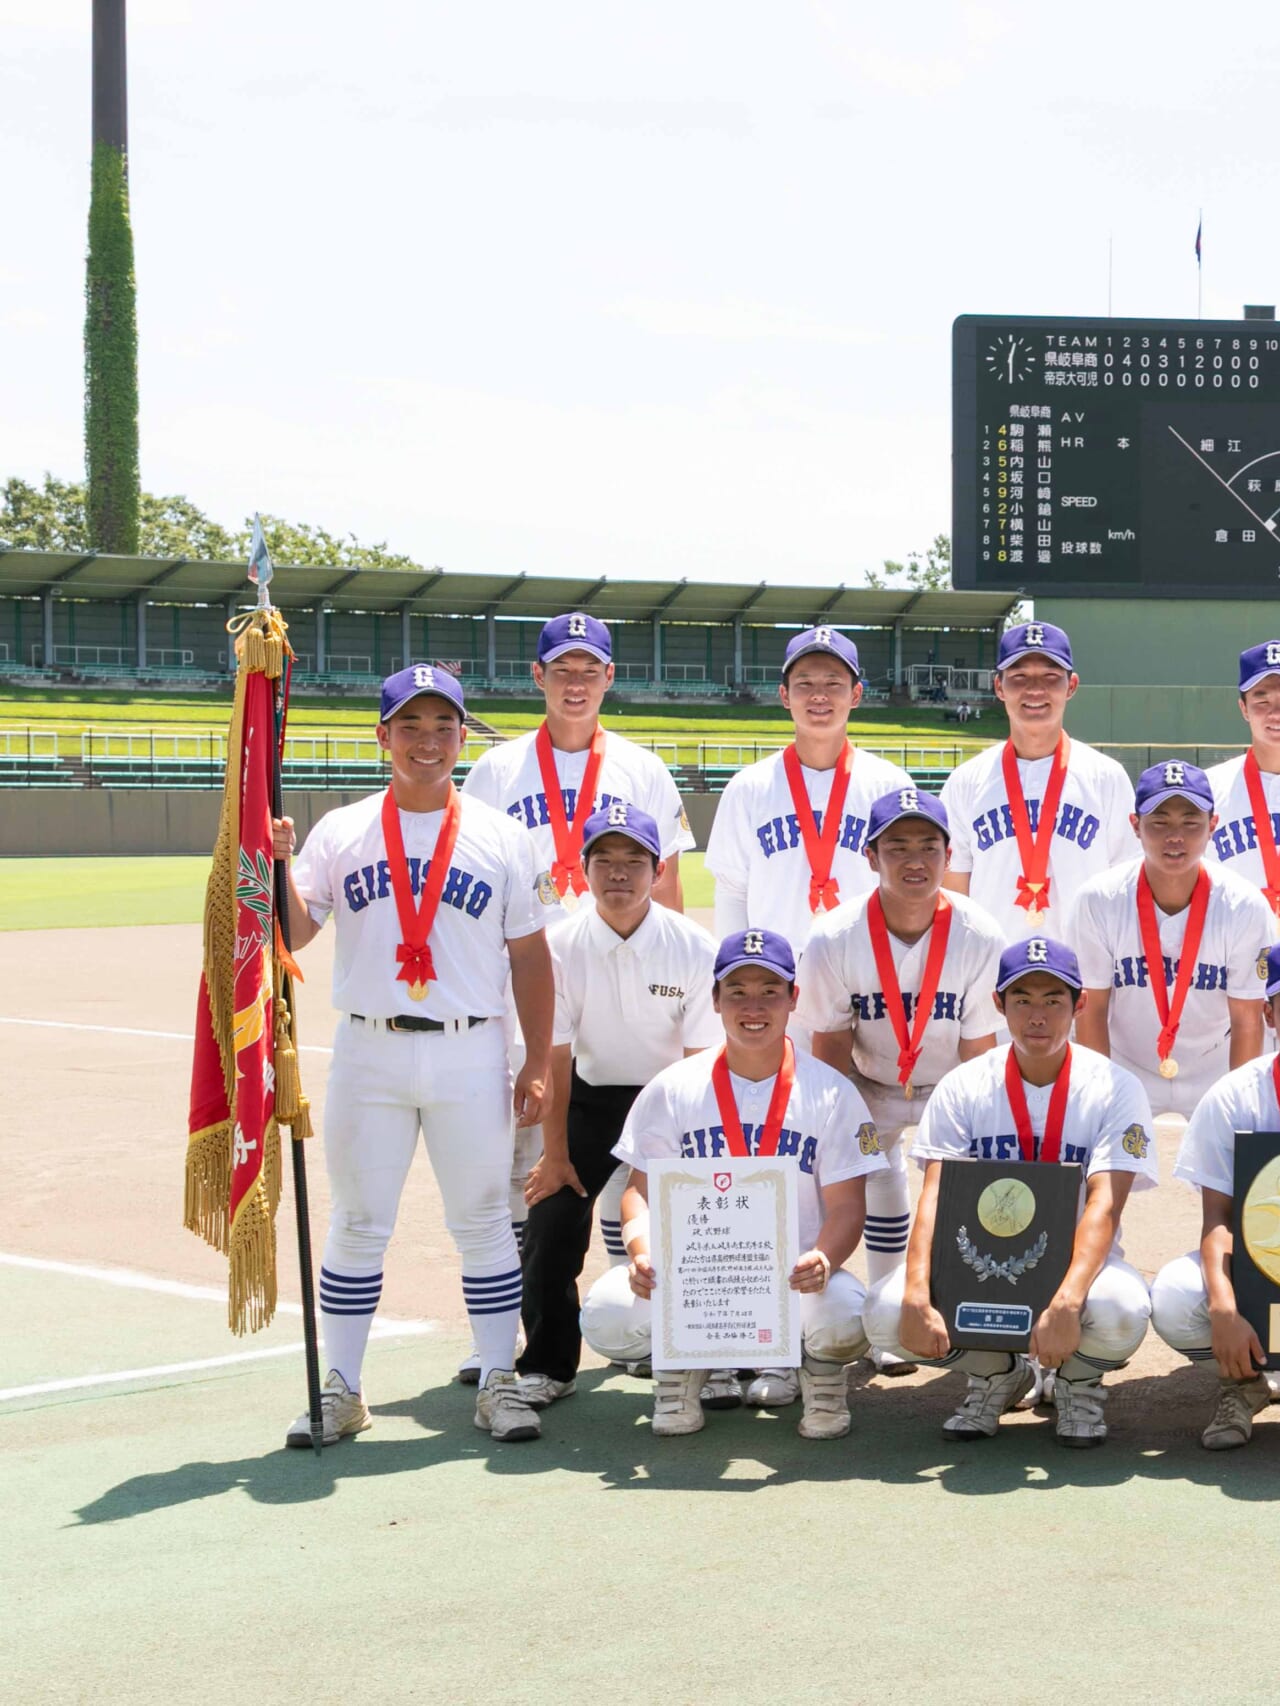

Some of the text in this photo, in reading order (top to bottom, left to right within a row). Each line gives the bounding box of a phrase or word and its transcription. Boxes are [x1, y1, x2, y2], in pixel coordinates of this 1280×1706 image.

[1046, 336, 1097, 346] TEAM
[1108, 337, 1111, 346] 1
[1124, 337, 1130, 347] 2
[1142, 337, 1149, 348] 3
[1160, 338, 1166, 347] 4
[1178, 338, 1185, 348] 5
[1196, 339, 1203, 349] 6
[1215, 339, 1221, 348] 7
[1233, 339, 1240, 349] 8
[1250, 340, 1257, 350] 9
[1266, 340, 1278, 350] 10
[1045, 352, 1097, 367] 県岐阜商
[1104, 354, 1113, 366] 0
[1123, 354, 1131, 366] 4
[1141, 354, 1150, 367] 0
[1159, 355, 1168, 367] 3
[1180, 356, 1184, 367] 1
[1196, 356, 1204, 368] 2
[1213, 356, 1222, 368] 0
[1232, 356, 1240, 369] 0
[1250, 357, 1258, 369] 0
[1045, 371, 1097, 386] 帝京大可児
[1104, 372, 1113, 385] 0
[1123, 373, 1131, 385] 0
[1141, 373, 1149, 386] 0
[1159, 374, 1168, 386] 0
[1177, 374, 1186, 386] 0
[1195, 374, 1204, 387] 0
[1213, 375, 1222, 387] 0
[1231, 375, 1240, 387] 0
[1249, 375, 1258, 388] 0
[985, 425, 988, 433] 1
[999, 425, 1006, 435] 4
[984, 440, 989, 449] 2
[999, 440, 1007, 451] 6
[1118, 438, 1129, 449] 本
[1201, 439, 1240, 452] 細江
[983, 456, 1051, 468] 3 5 内山
[984, 471, 1050, 484] 4 3 坂口
[984, 487, 1007, 498] 5 9
[1061, 496, 1097, 507] SPEED
[983, 504, 989, 513] 6
[998, 503, 1007, 514] 2
[984, 519, 1051, 531] 7 7 横山
[983, 534, 1051, 546] 8 1 柴田
[1108, 529, 1135, 540] km/h
[1216, 529, 1255, 542] 倉田
[1062, 542, 1101, 554] 投球数
[983, 550, 1007, 561] 9 8
[568, 616, 586, 638] G
[413, 667, 433, 688] G
[744, 931, 764, 955] G
[1027, 940, 1048, 963] G
[697, 1196, 750, 1210] 表彰状
